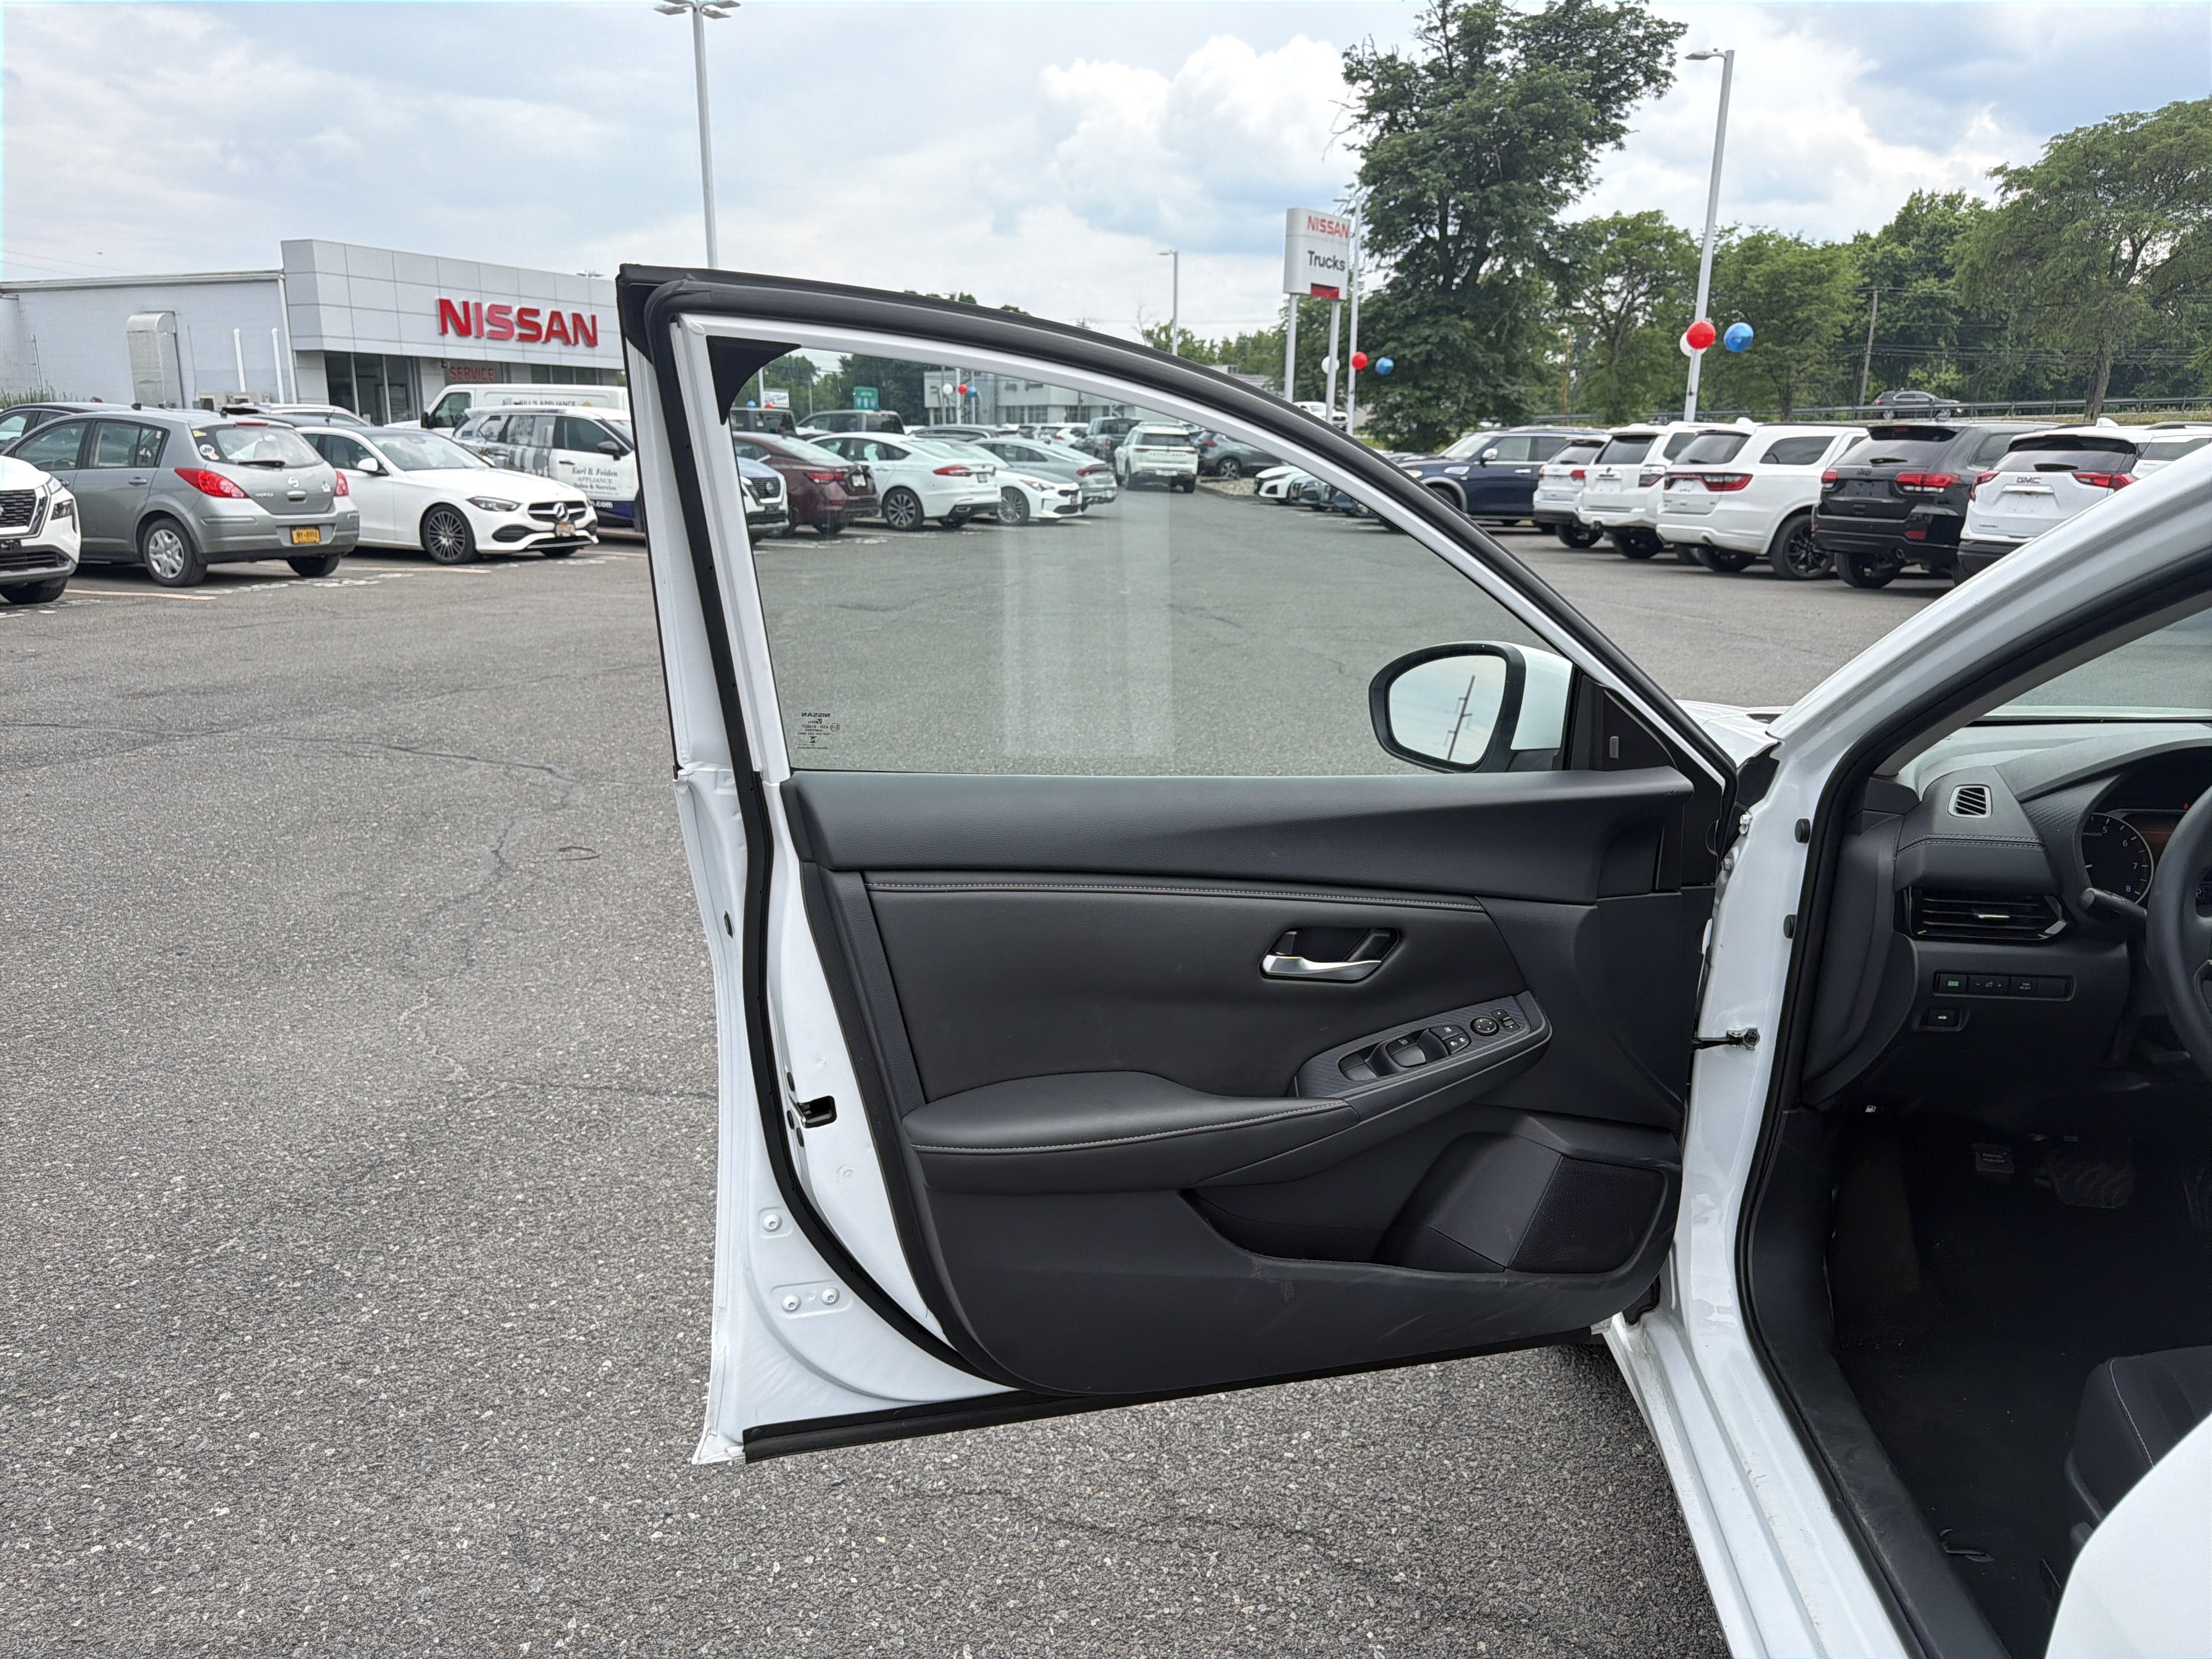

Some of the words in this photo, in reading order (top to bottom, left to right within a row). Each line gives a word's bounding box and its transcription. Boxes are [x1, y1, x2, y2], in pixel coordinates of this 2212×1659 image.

[1307, 215, 1350, 239] NISSAN
[1307, 250, 1345, 272] Trucks
[439, 298, 598, 347] NISSAN
[449, 366, 493, 382] SERVICE
